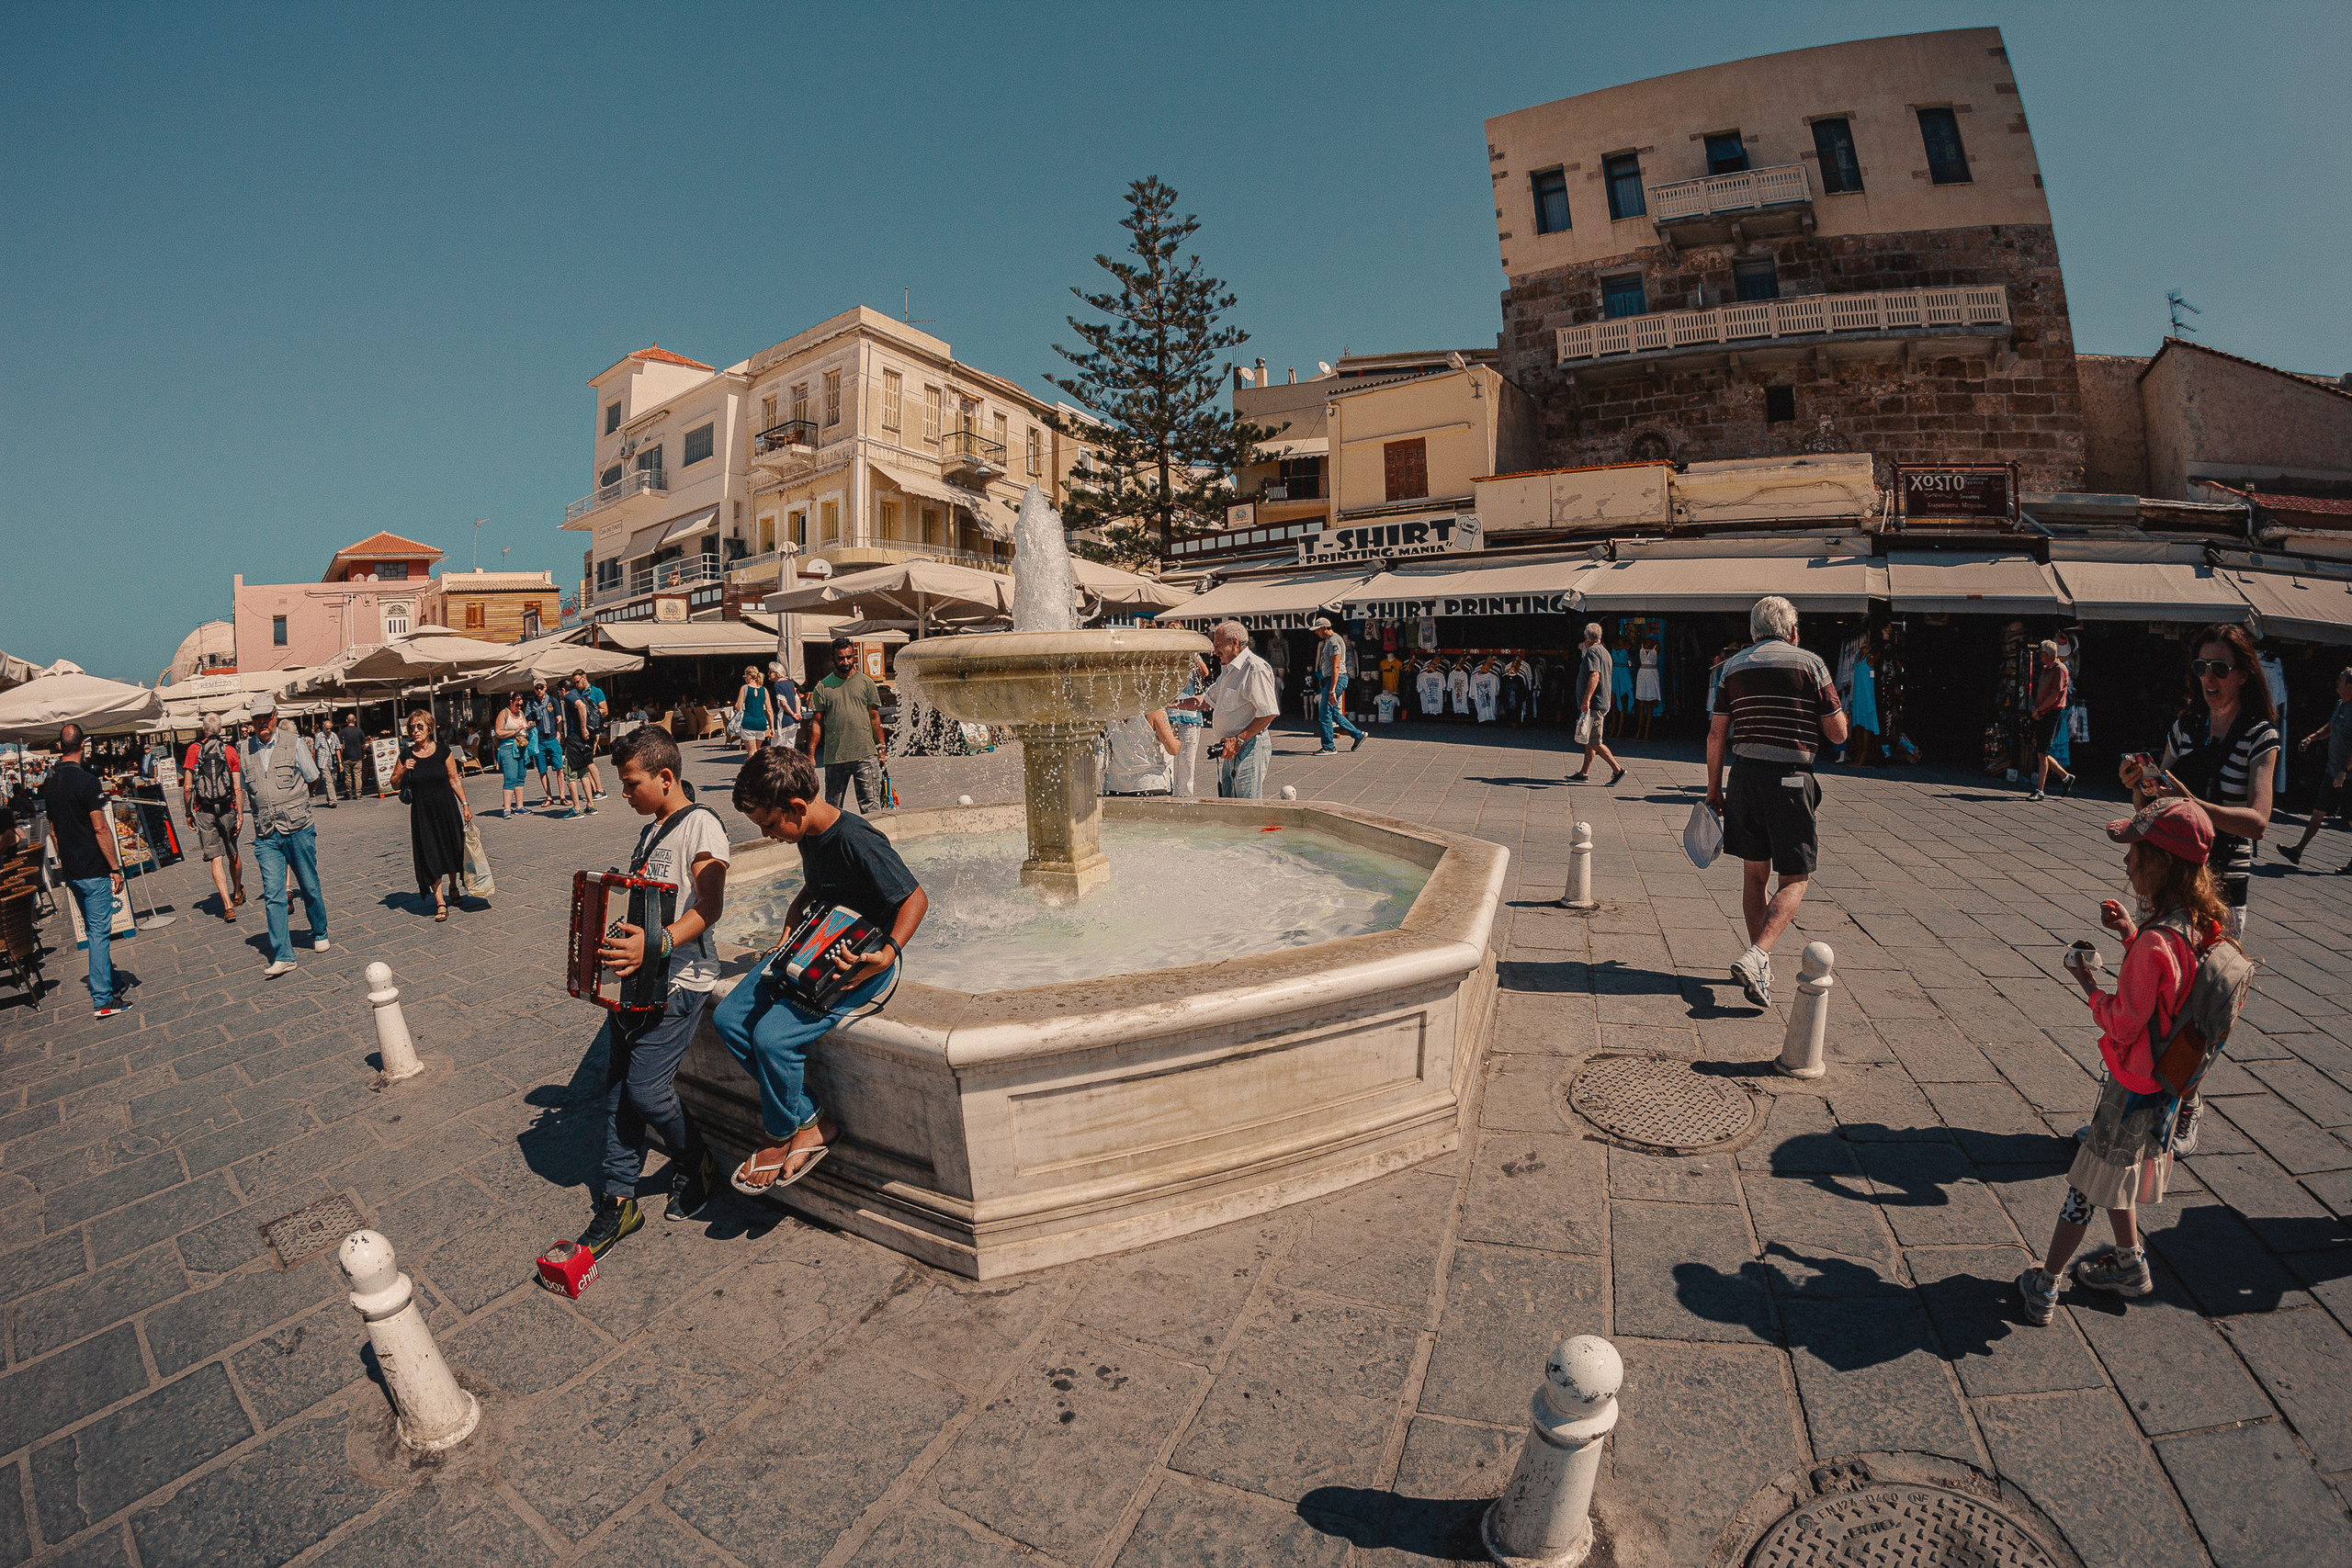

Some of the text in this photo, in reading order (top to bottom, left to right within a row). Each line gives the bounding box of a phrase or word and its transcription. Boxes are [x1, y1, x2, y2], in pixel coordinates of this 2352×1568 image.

[1298, 518, 1456, 555] T-SHIRT
[1342, 600, 1436, 619] T-SHIRT
[199, 680, 232, 690] REMEZZO
[542, 1276, 568, 1294] box
[577, 1263, 599, 1291] chill
[1912, 1493, 1930, 1505] NF
